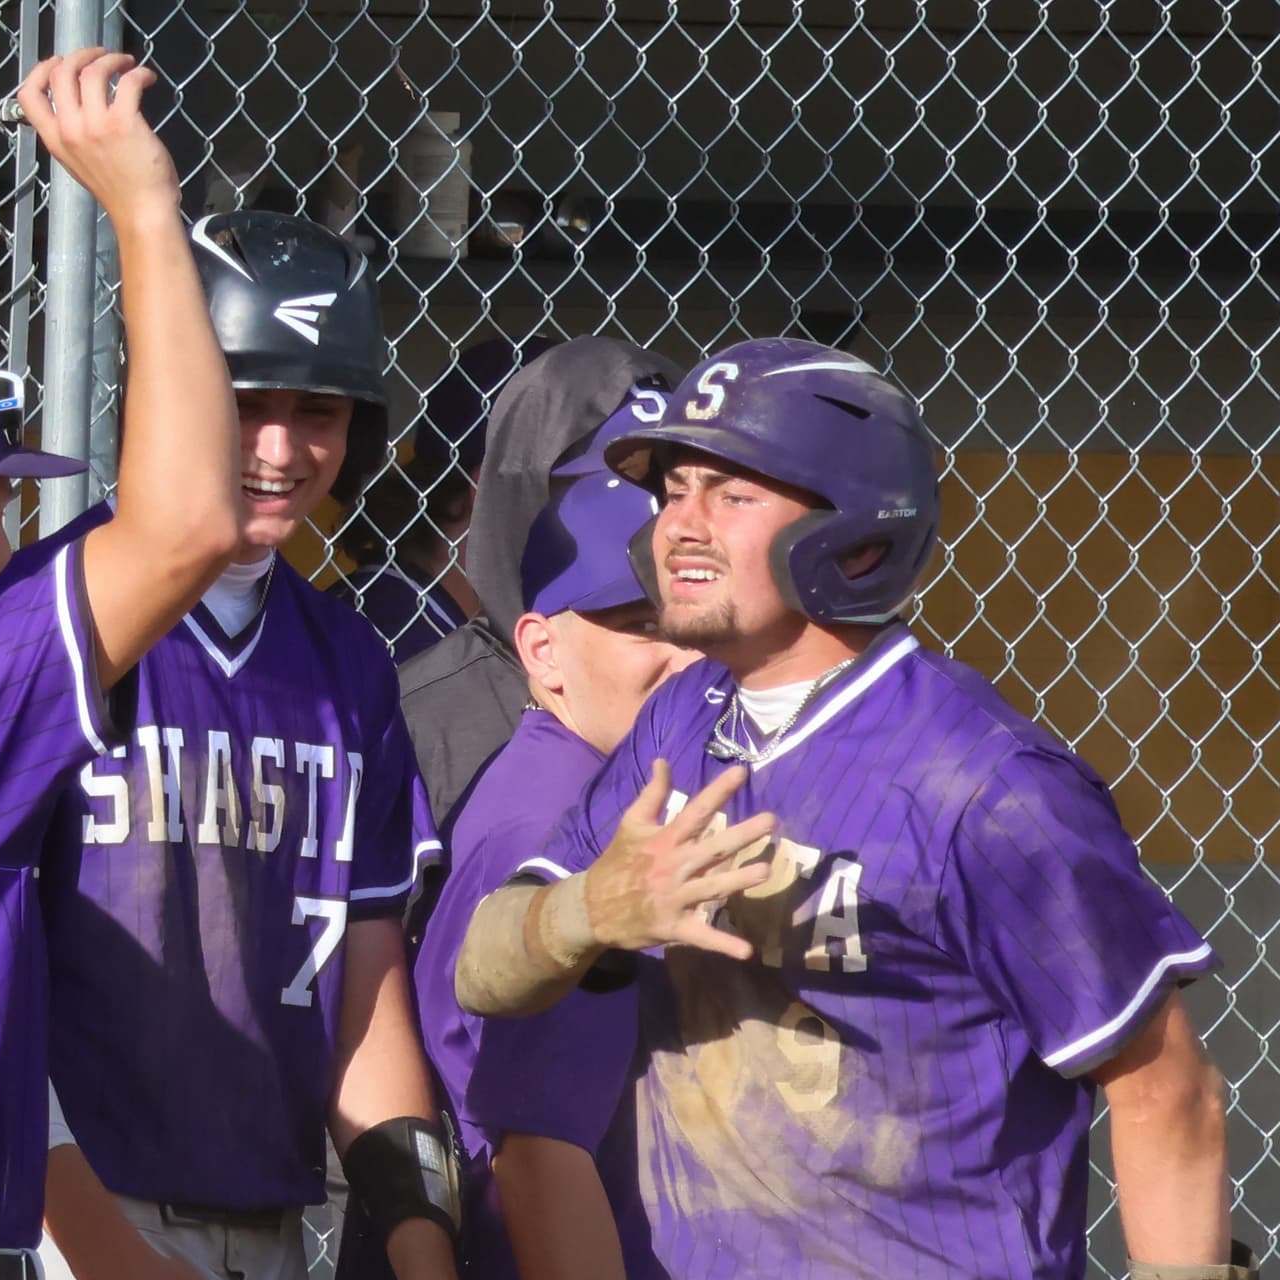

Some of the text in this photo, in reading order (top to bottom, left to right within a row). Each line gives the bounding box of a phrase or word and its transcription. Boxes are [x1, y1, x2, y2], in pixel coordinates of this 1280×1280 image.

[685, 362, 739, 420] S
[280, 896, 349, 1007] 7
[775, 1001, 842, 1113] 9
